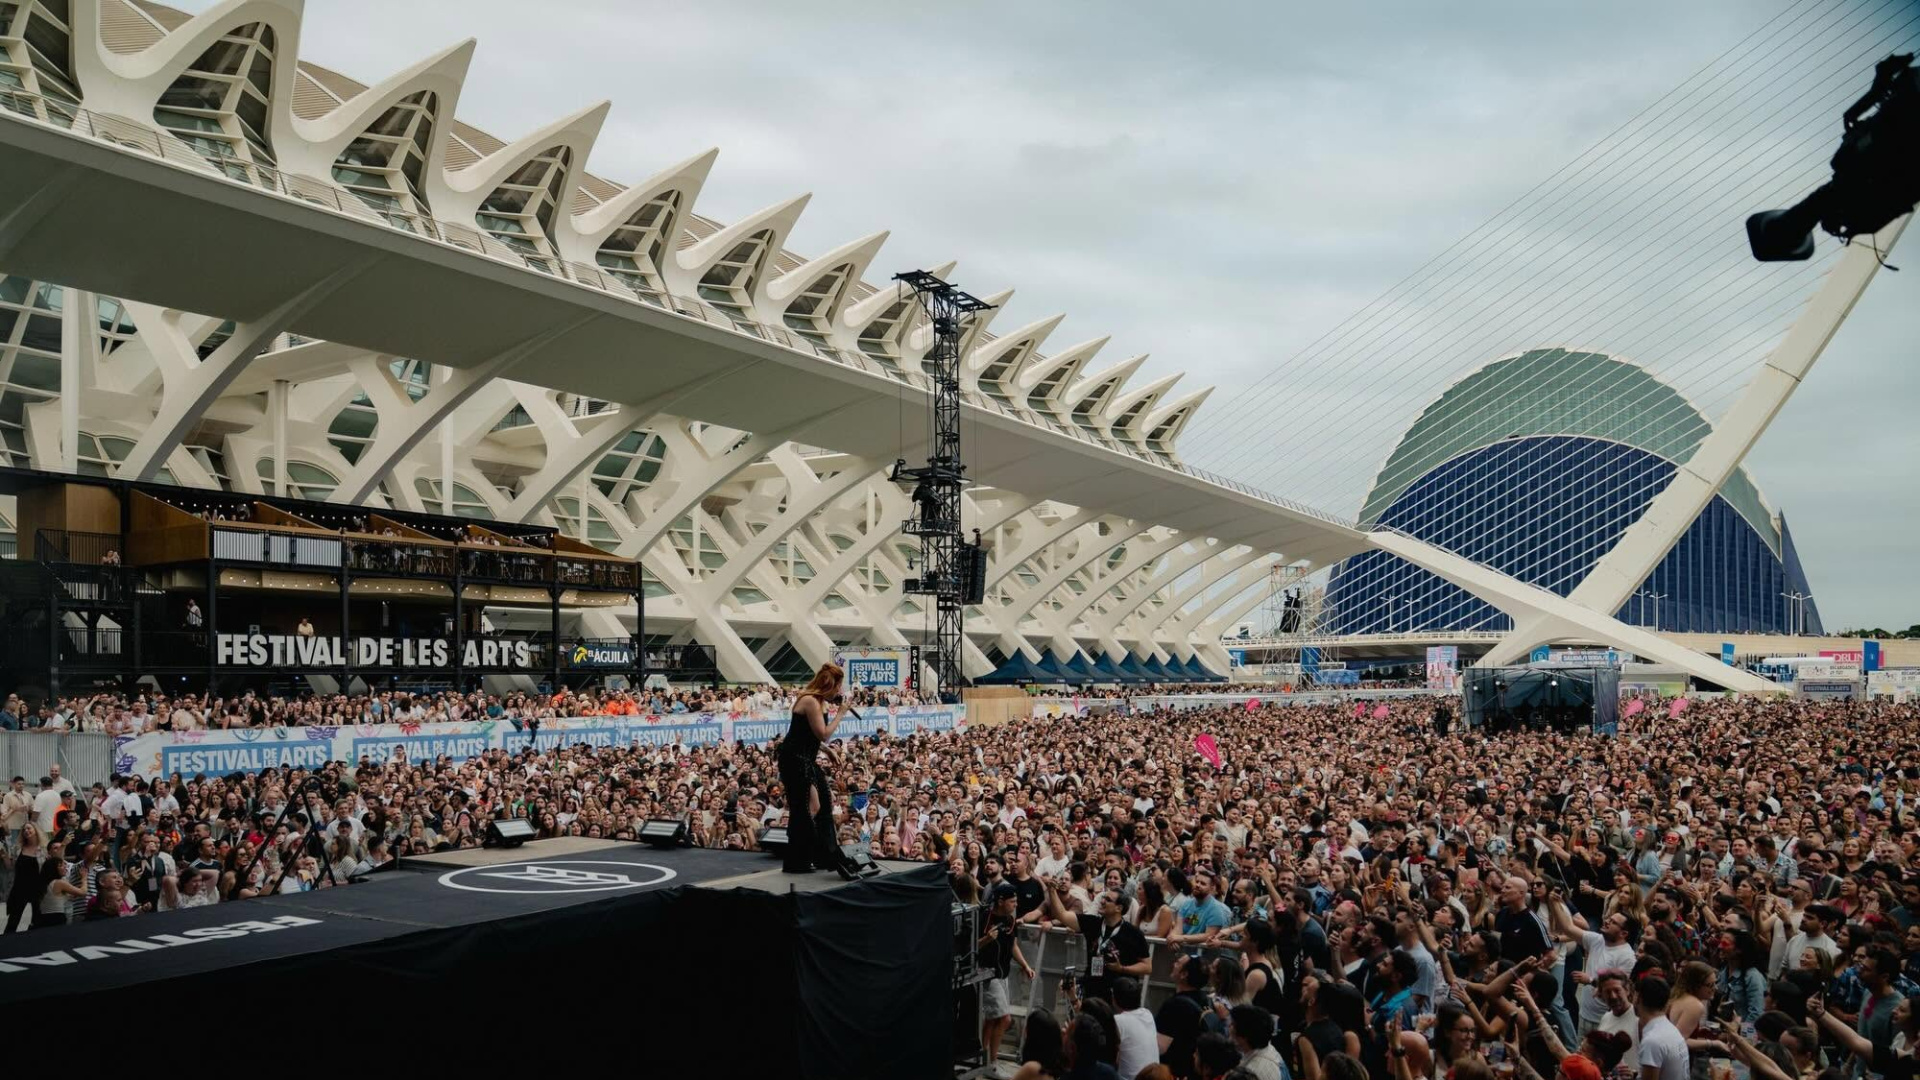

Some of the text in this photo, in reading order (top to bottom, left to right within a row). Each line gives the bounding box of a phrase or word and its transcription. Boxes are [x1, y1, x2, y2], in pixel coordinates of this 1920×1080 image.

[217, 633, 530, 667] FESTIVAL DE LES ARTS
[587, 648, 630, 664] EL ÁGUILA
[851, 662, 896, 671] FESTIVAL DE
[851, 671, 896, 683] LES ARTS
[692, 727, 720, 744] ARTS
[446, 738, 485, 758] ARTS
[168, 748, 261, 774] FESTIVAL
[263, 747, 278, 759] DE
[280, 744, 328, 768] ARTS
